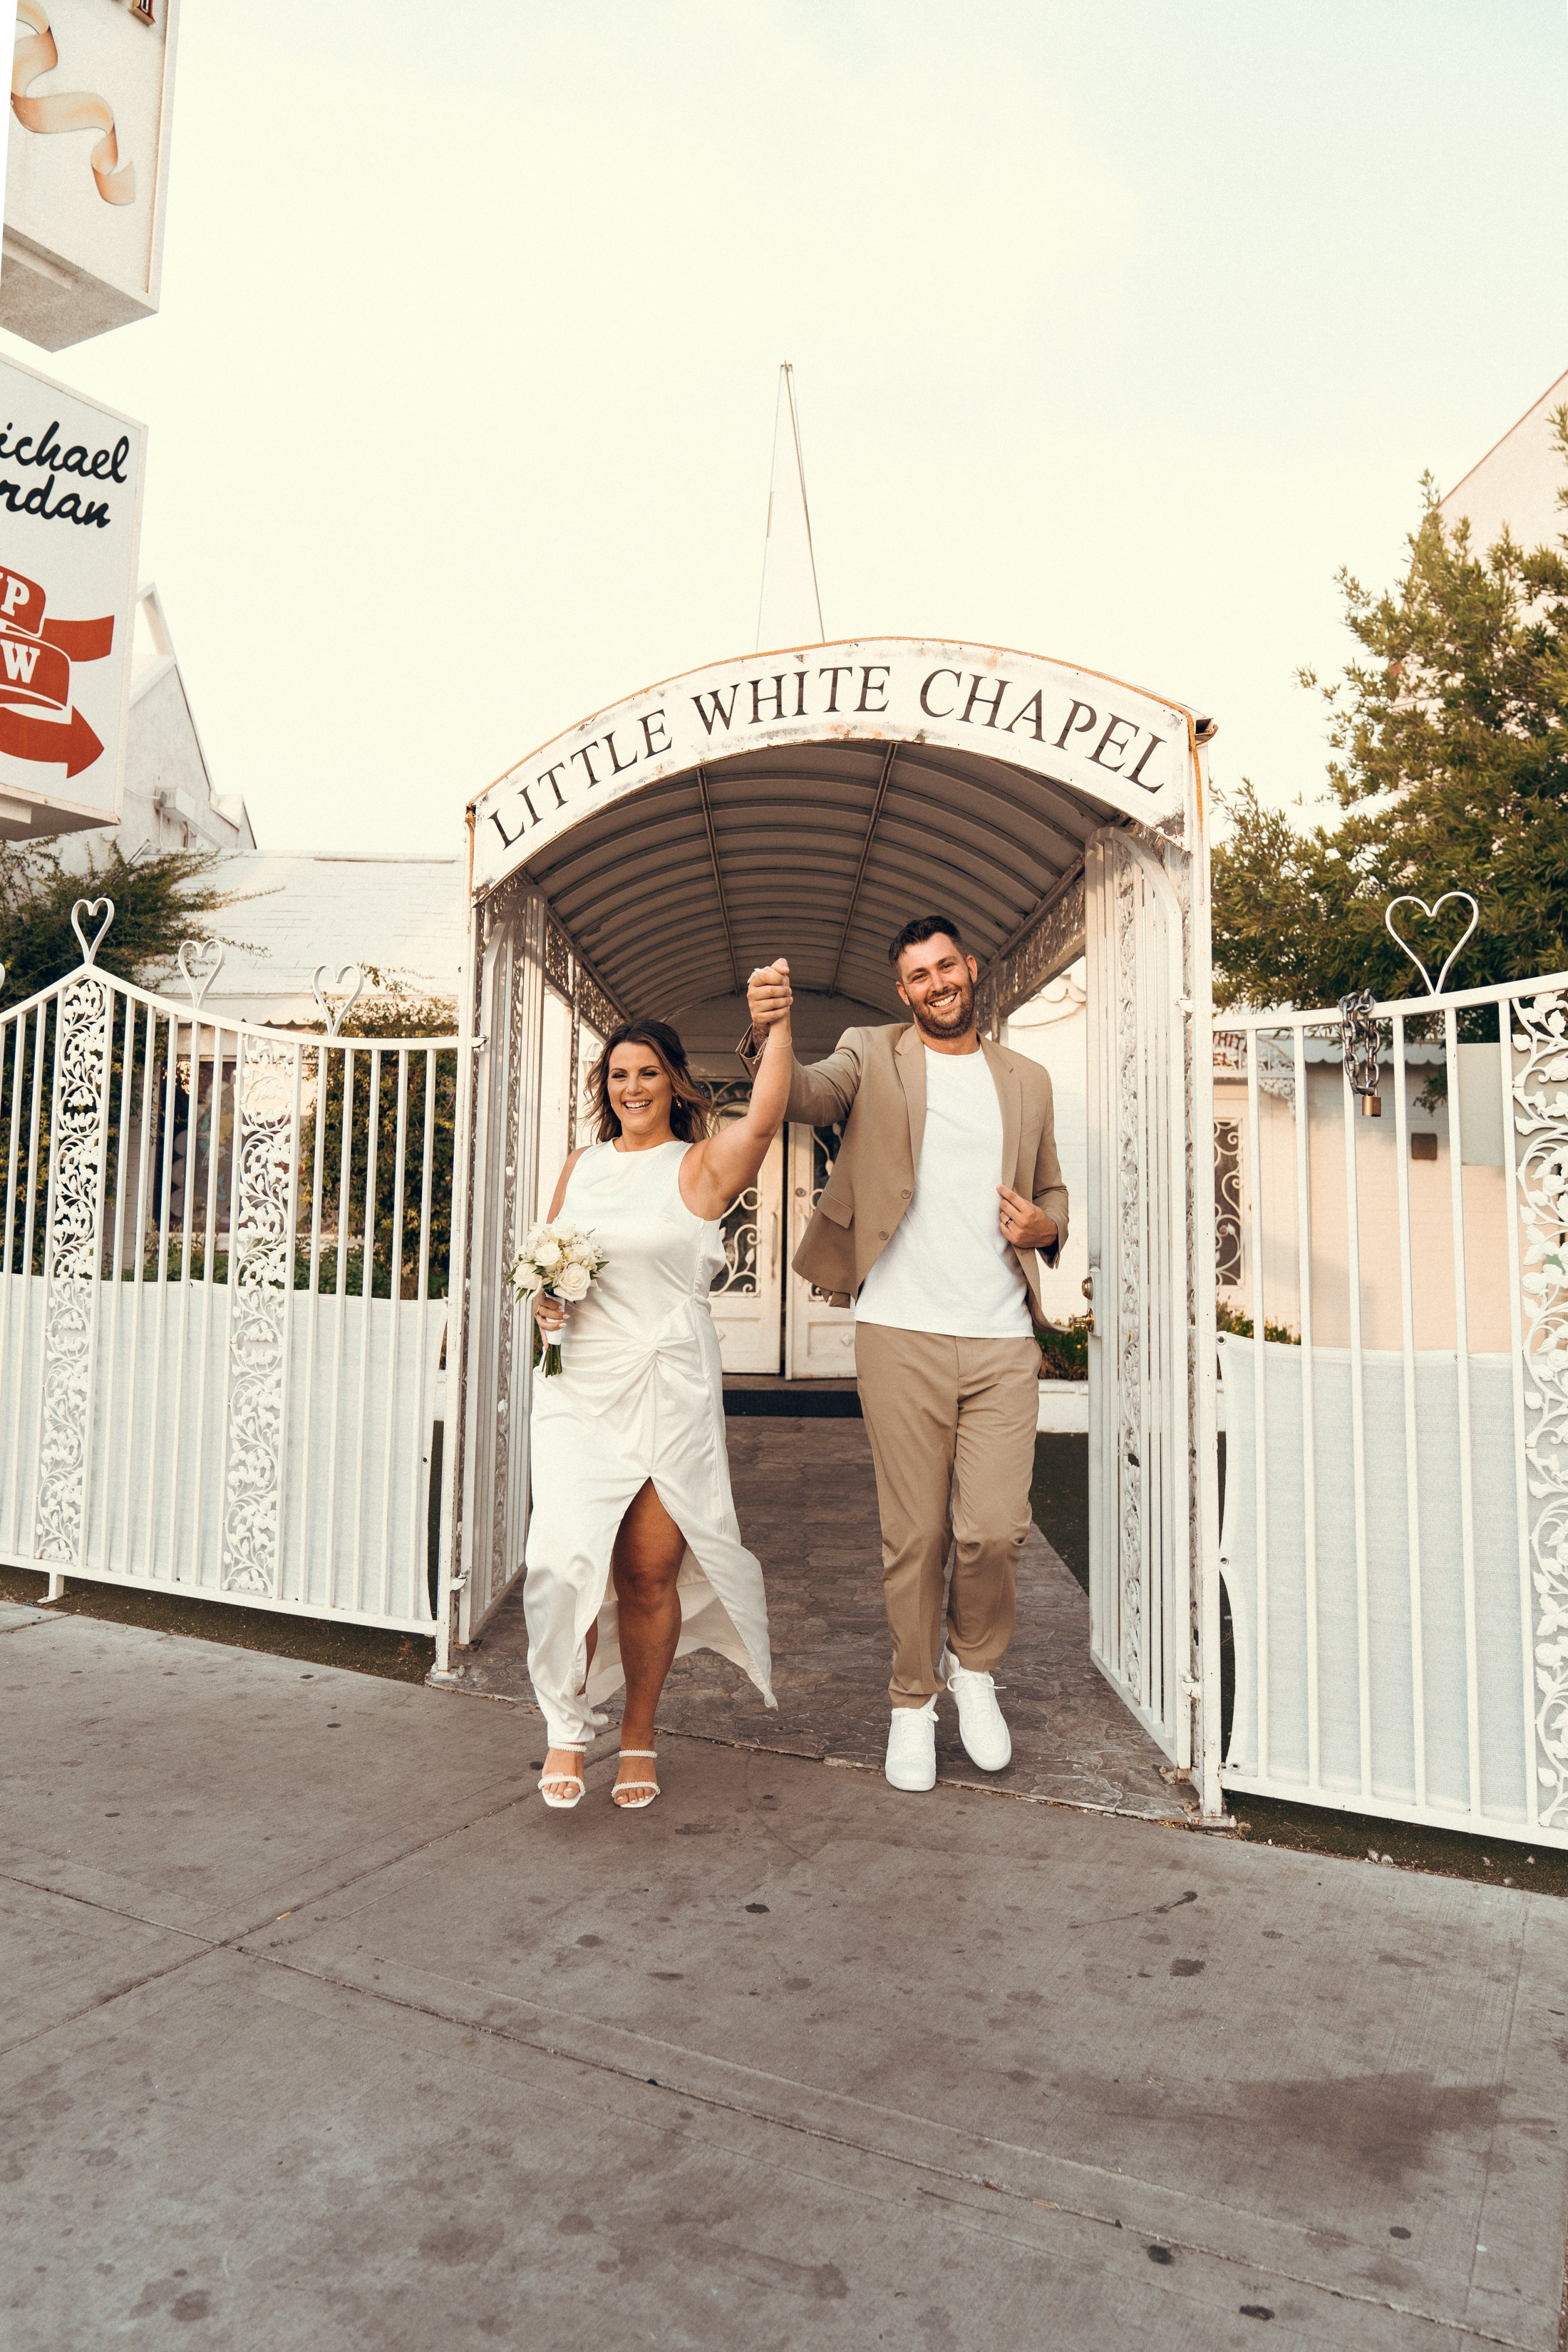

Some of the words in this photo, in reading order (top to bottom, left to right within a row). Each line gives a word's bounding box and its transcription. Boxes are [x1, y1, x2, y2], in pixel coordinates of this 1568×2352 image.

[0, 572, 30, 617] P
[487, 708, 673, 850] LITTLE
[690, 665, 891, 736] WHITE
[919, 669, 1167, 794] CHAPEL
